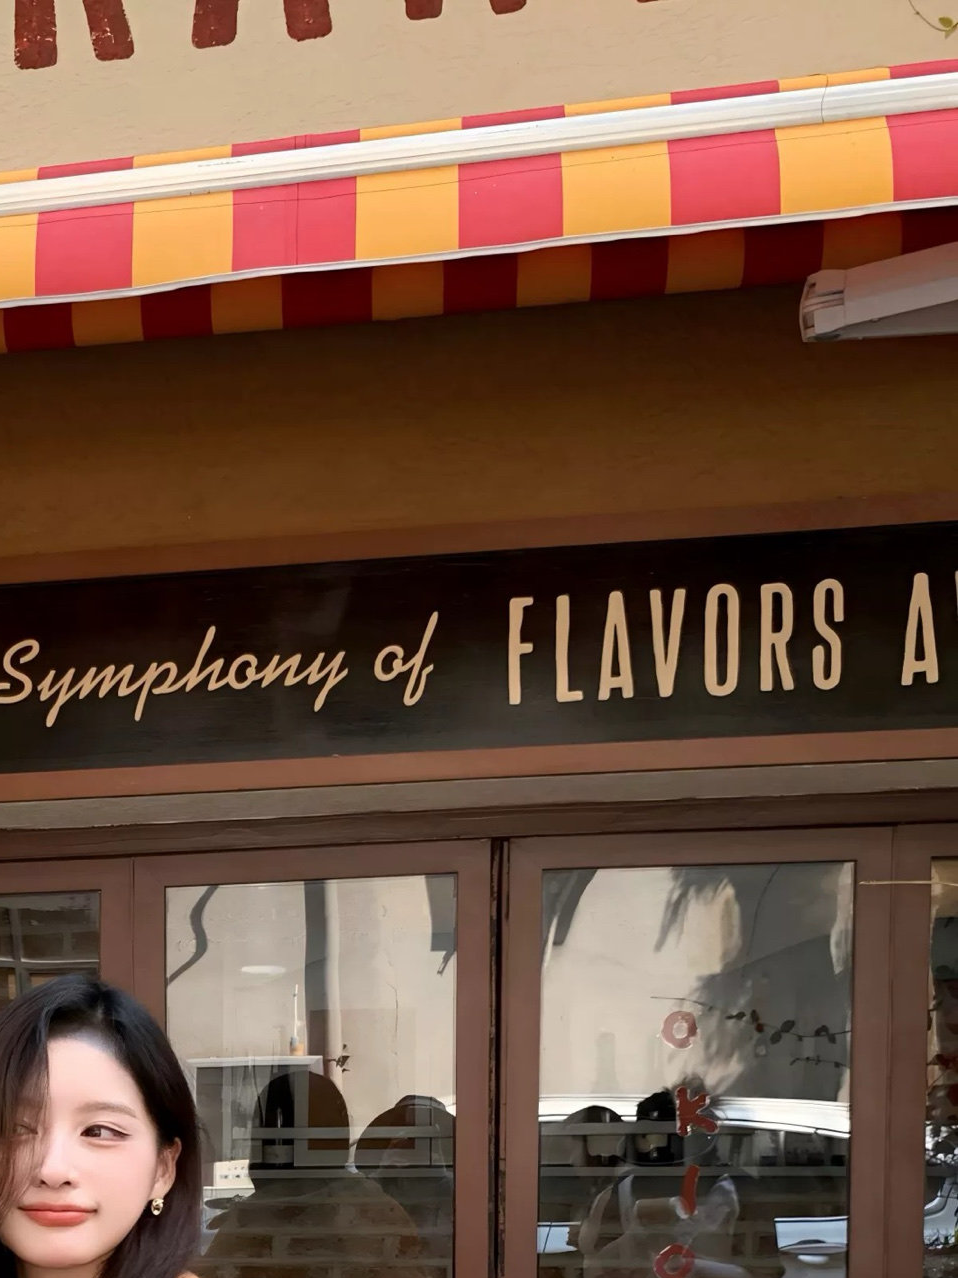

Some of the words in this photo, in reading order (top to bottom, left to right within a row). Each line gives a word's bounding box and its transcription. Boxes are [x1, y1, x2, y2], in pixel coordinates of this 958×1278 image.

[374, 611, 439, 706] of
[508, 578, 844, 705] FLAVORS
[901, 571, 958, 686] A
